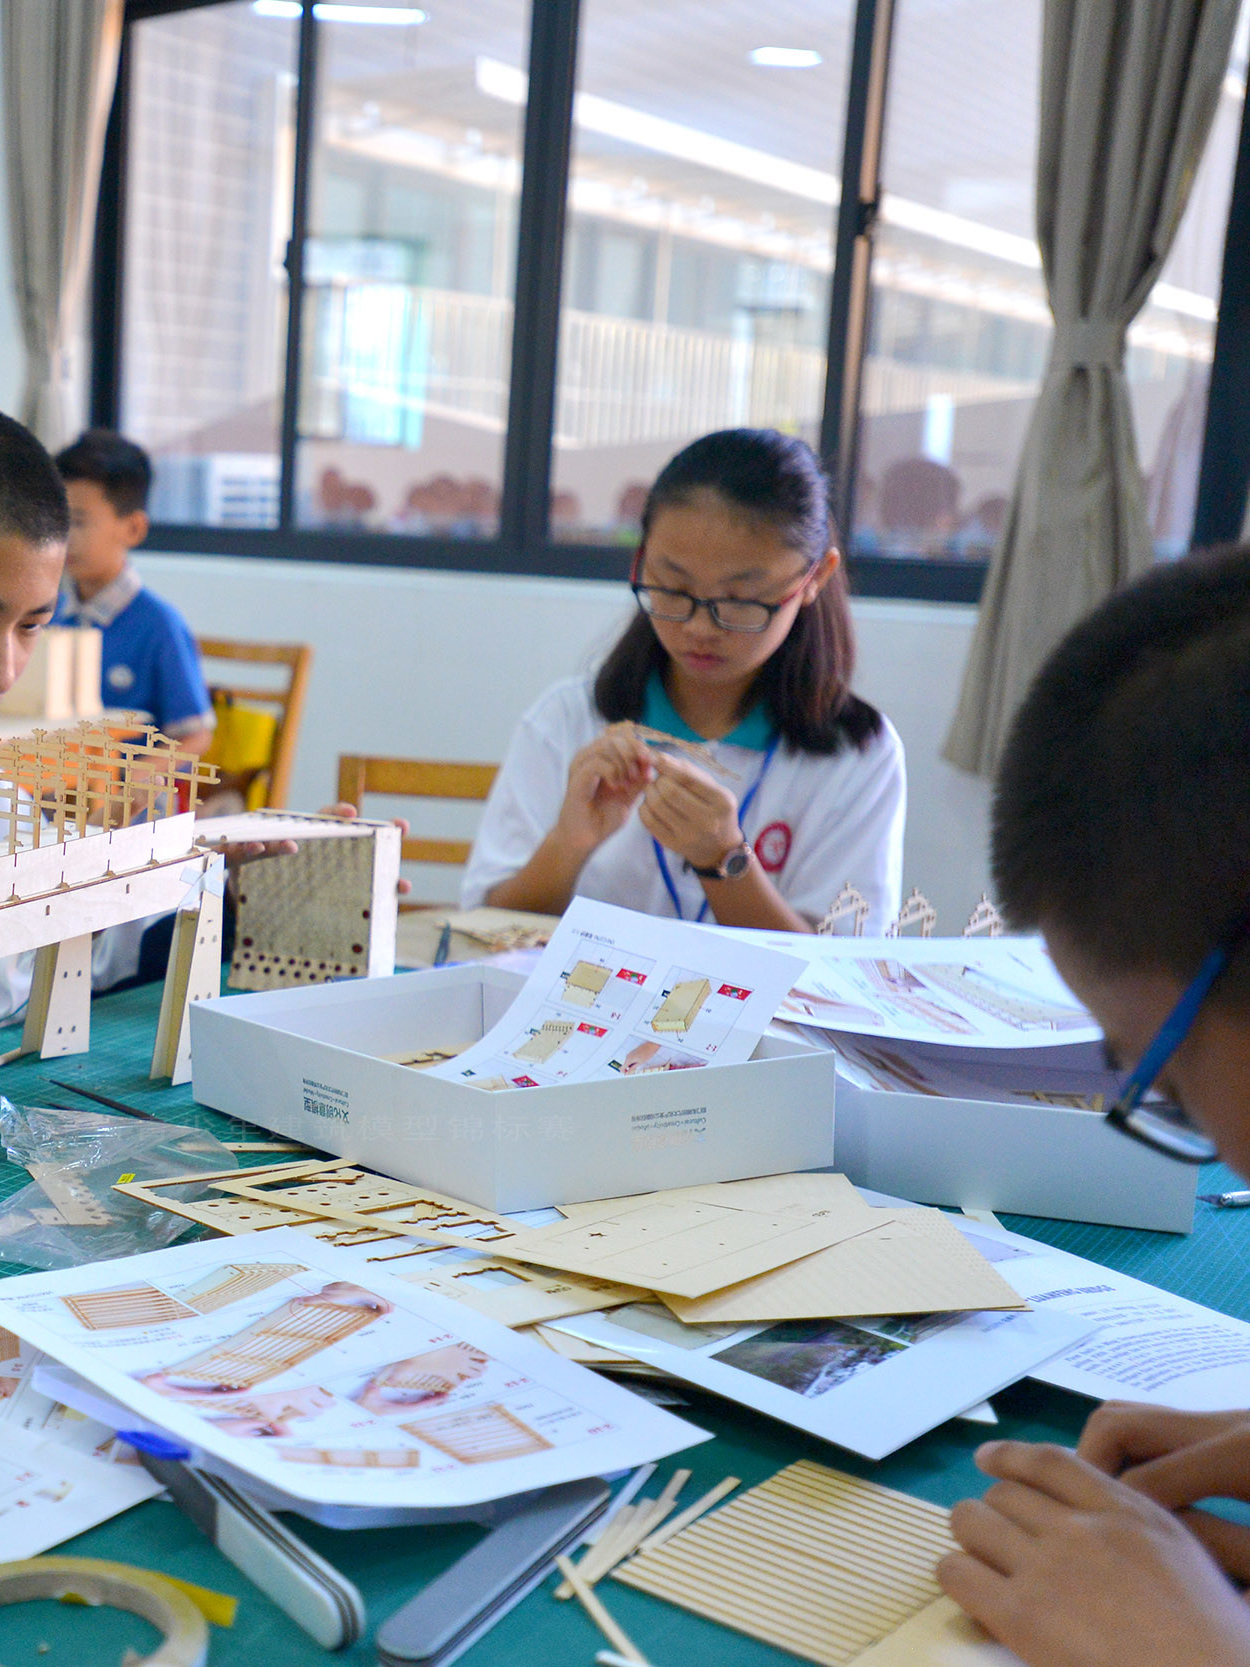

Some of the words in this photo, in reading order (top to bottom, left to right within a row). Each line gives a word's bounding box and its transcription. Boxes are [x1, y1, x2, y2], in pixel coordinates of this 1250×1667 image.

[303, 1096, 350, 1125] 文化创意模型
